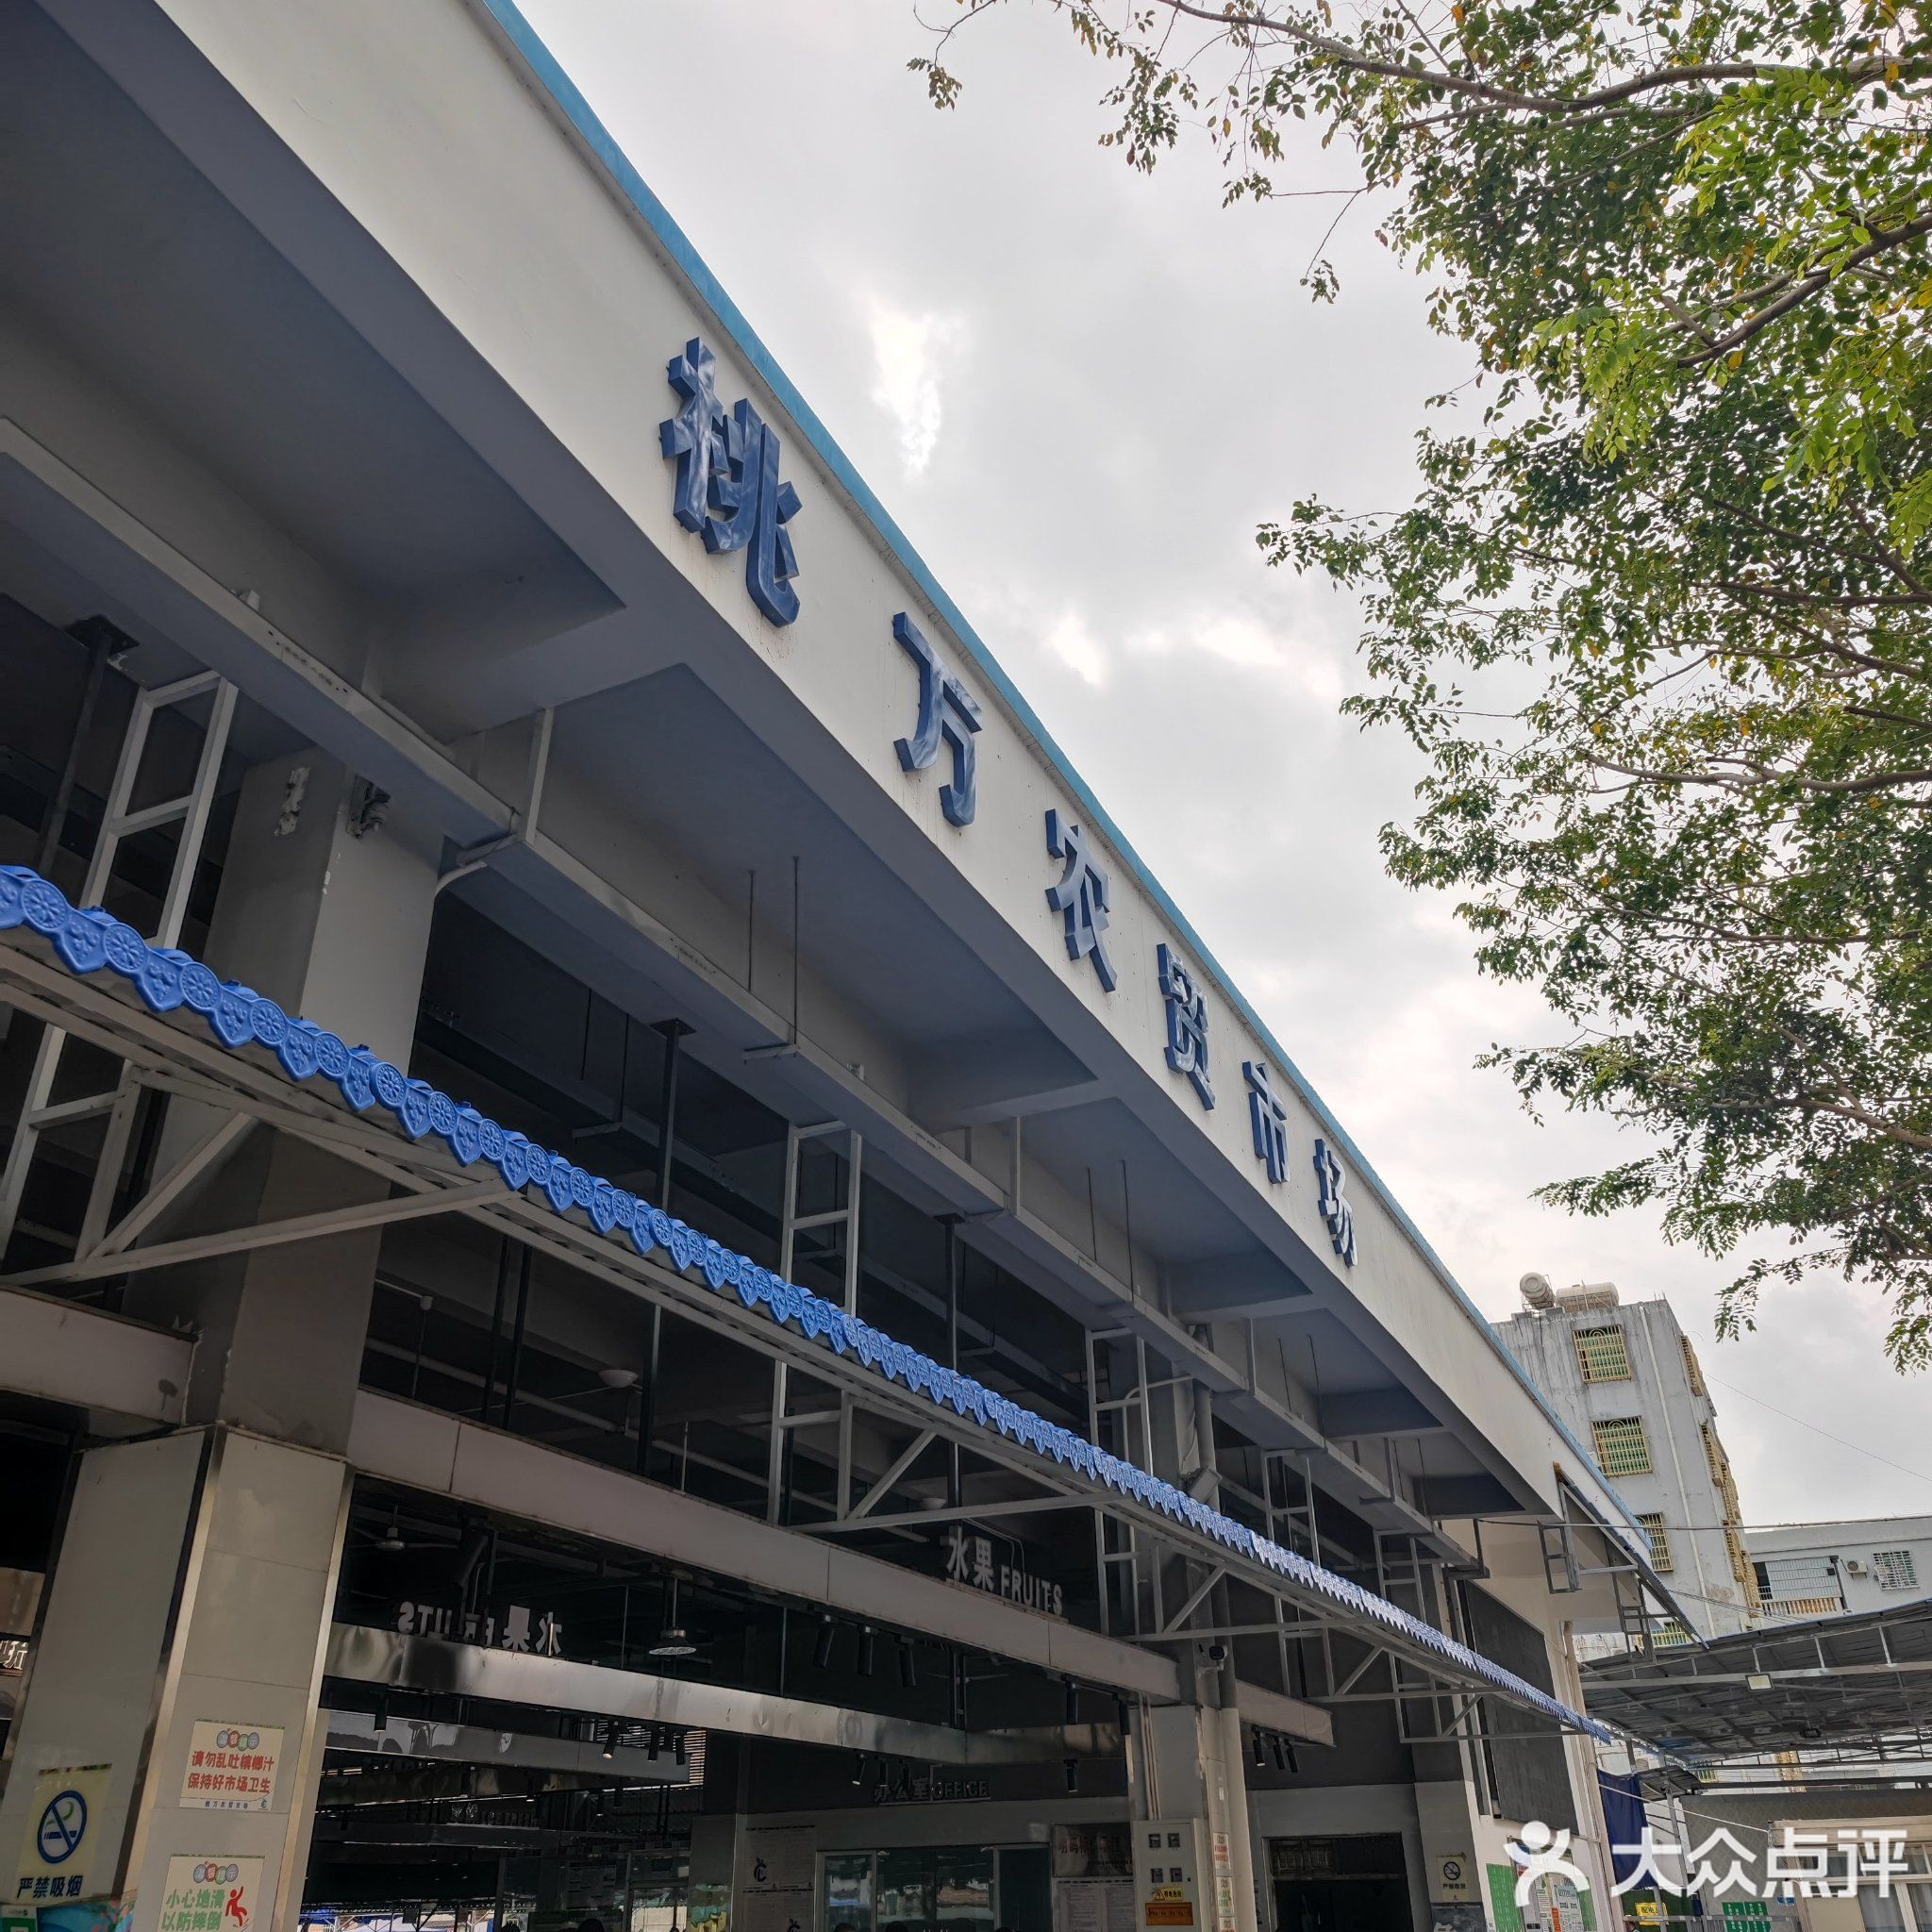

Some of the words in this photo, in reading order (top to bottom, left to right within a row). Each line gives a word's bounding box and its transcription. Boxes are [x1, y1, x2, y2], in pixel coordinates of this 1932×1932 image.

[944, 1525, 995, 1591] 水果
[1001, 1563, 1064, 1616] FRUITS
[192, 1750, 275, 1772] 请勿乱吐槟榔汁
[188, 1773, 271, 1793] 保持好市场卫生
[16, 1874, 84, 1899] 严禁吸烟
[166, 1888, 225, 1908] 小心地滑
[161, 1911, 223, 1931] 以防摔倒
